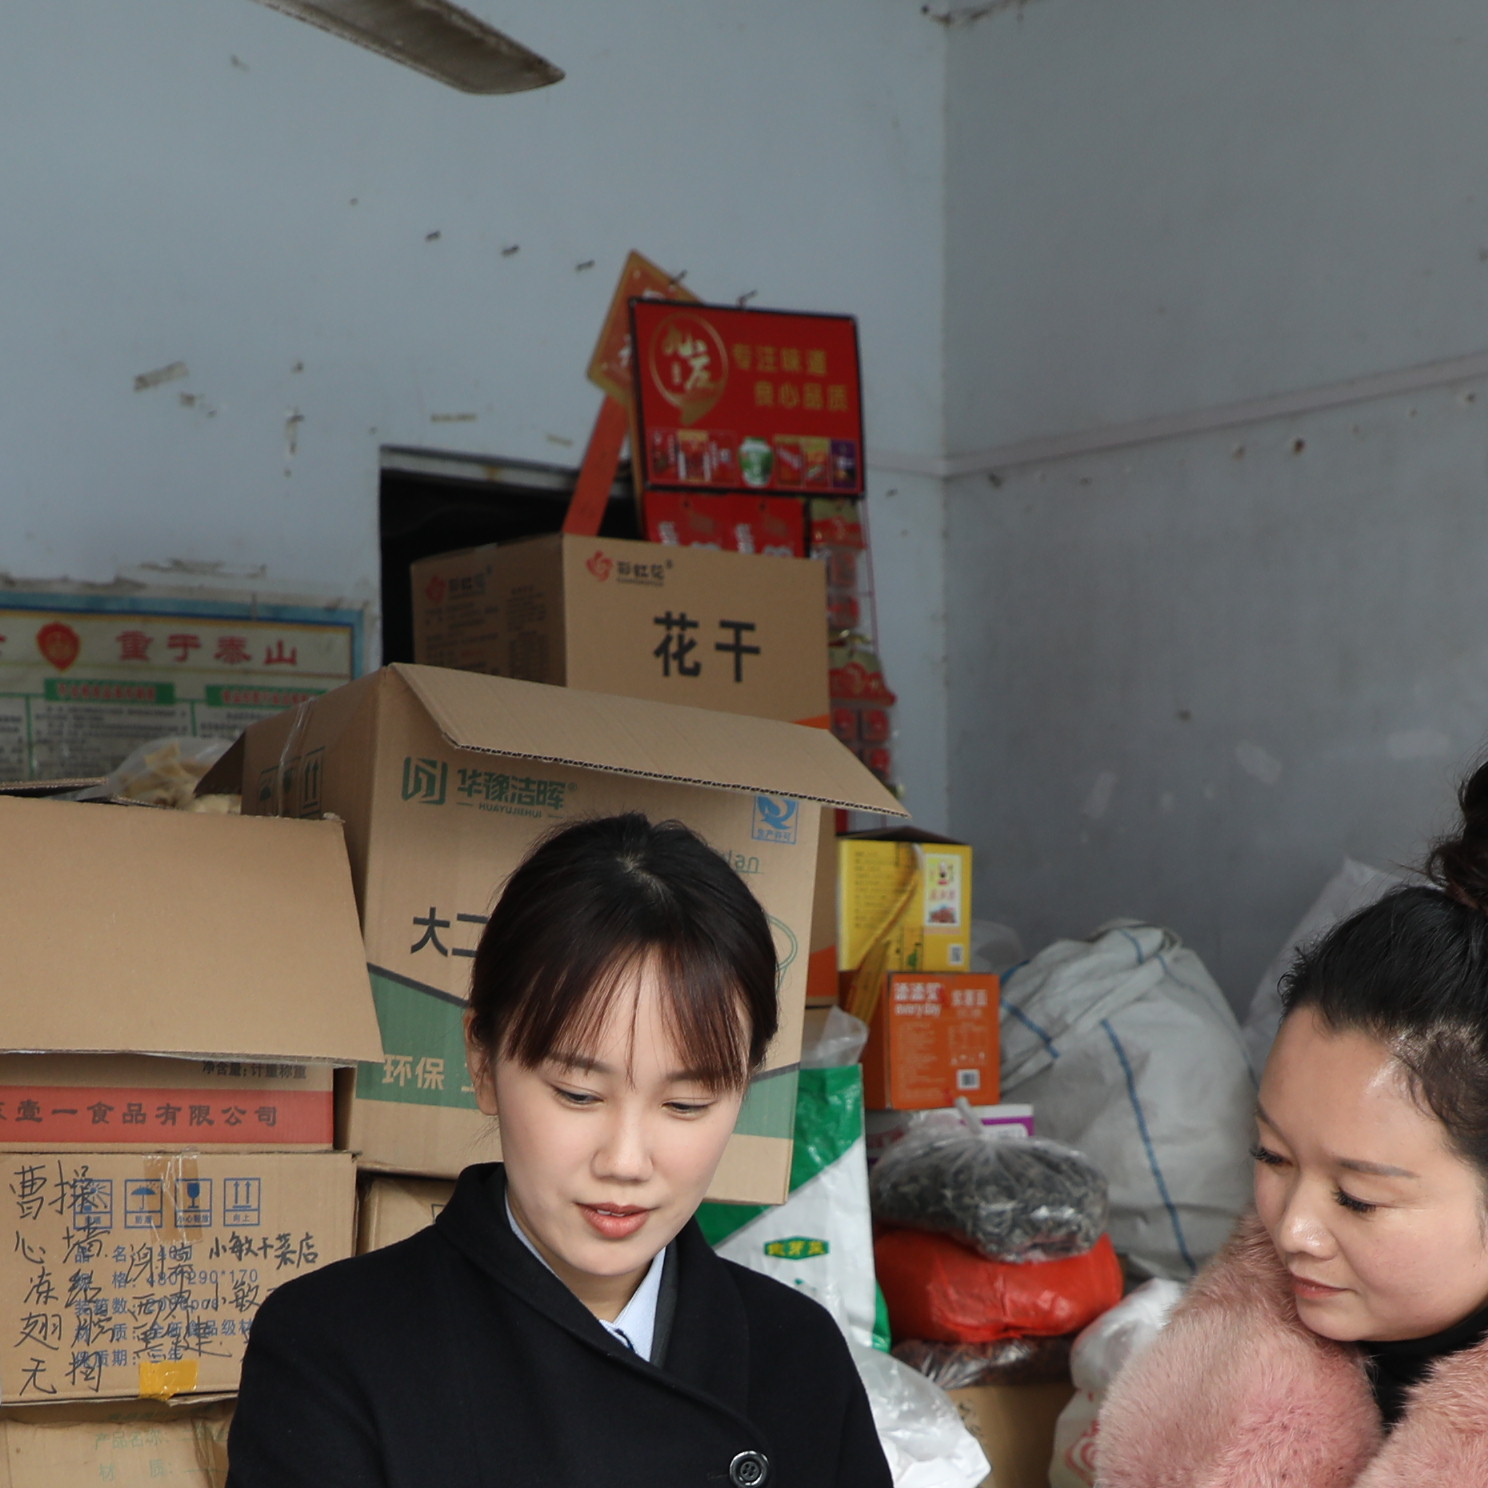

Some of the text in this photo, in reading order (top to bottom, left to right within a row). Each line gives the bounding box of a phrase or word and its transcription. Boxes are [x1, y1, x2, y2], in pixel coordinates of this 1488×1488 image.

[731, 343, 828, 376] 专注味道
[753, 380, 850, 413] 良心品质
[115, 630, 299, 667] 重于泰山
[652, 610, 761, 683] 花干
[456, 768, 566, 811] 华豫洁晖
[381, 1054, 446, 1092] 环保
